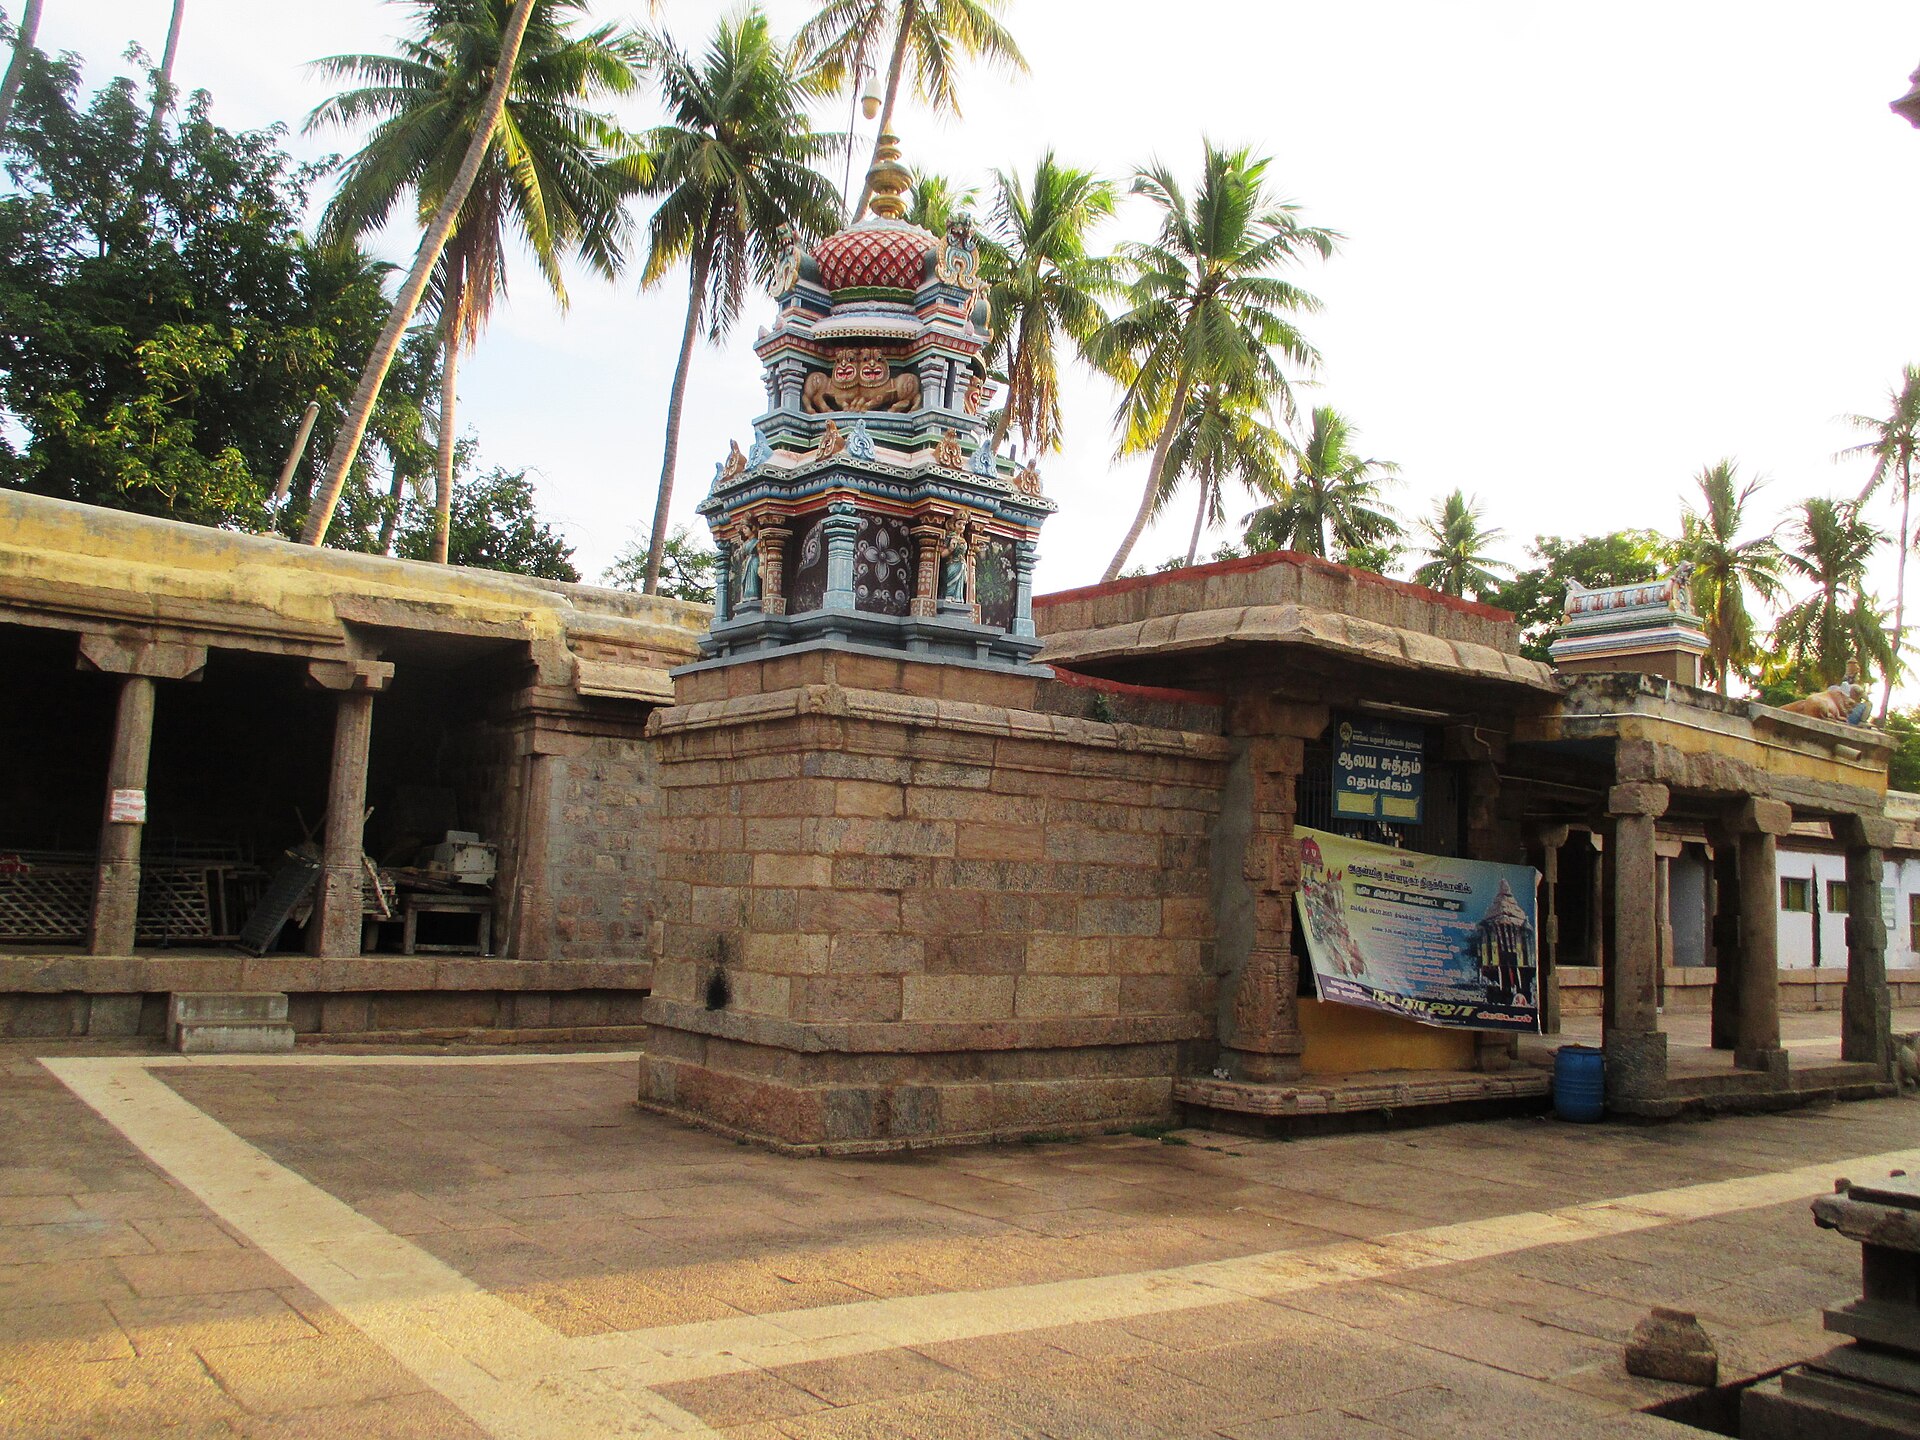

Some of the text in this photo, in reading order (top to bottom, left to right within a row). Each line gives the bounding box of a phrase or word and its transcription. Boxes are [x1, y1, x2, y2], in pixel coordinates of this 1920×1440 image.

[1338, 752, 1421, 777] ஆலய சுத்தம்
[1346, 774, 1412, 792] தெய்வீகம்
